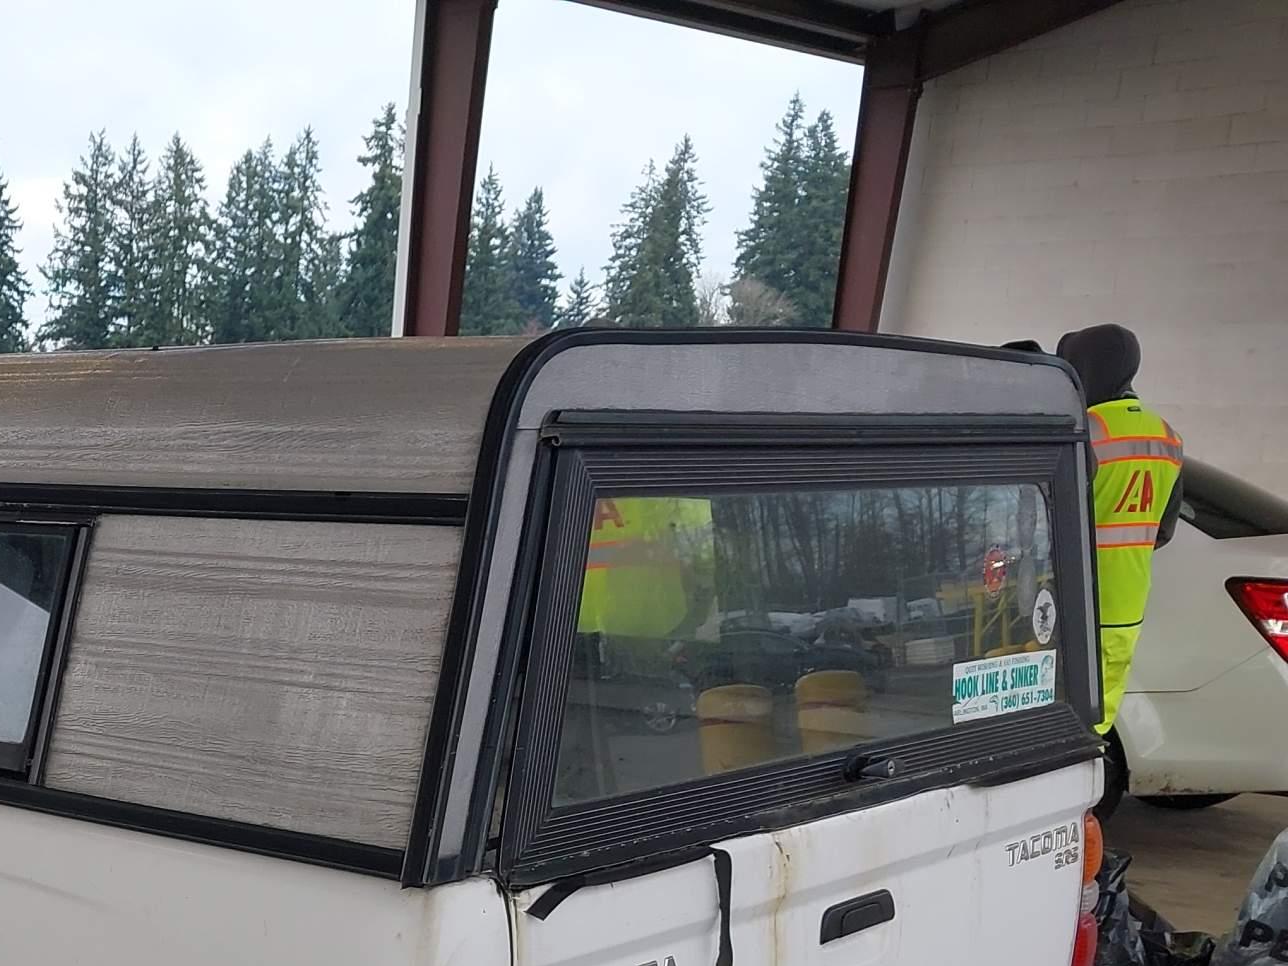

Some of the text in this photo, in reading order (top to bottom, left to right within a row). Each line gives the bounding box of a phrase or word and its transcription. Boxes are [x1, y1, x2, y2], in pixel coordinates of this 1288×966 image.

[954, 664, 1039, 701] HOOK LINE & SINKER
[1001, 694, 1020, 711] (360)
[1005, 822, 1080, 867] TACOMA
[1054, 846, 1080, 870] SR5
